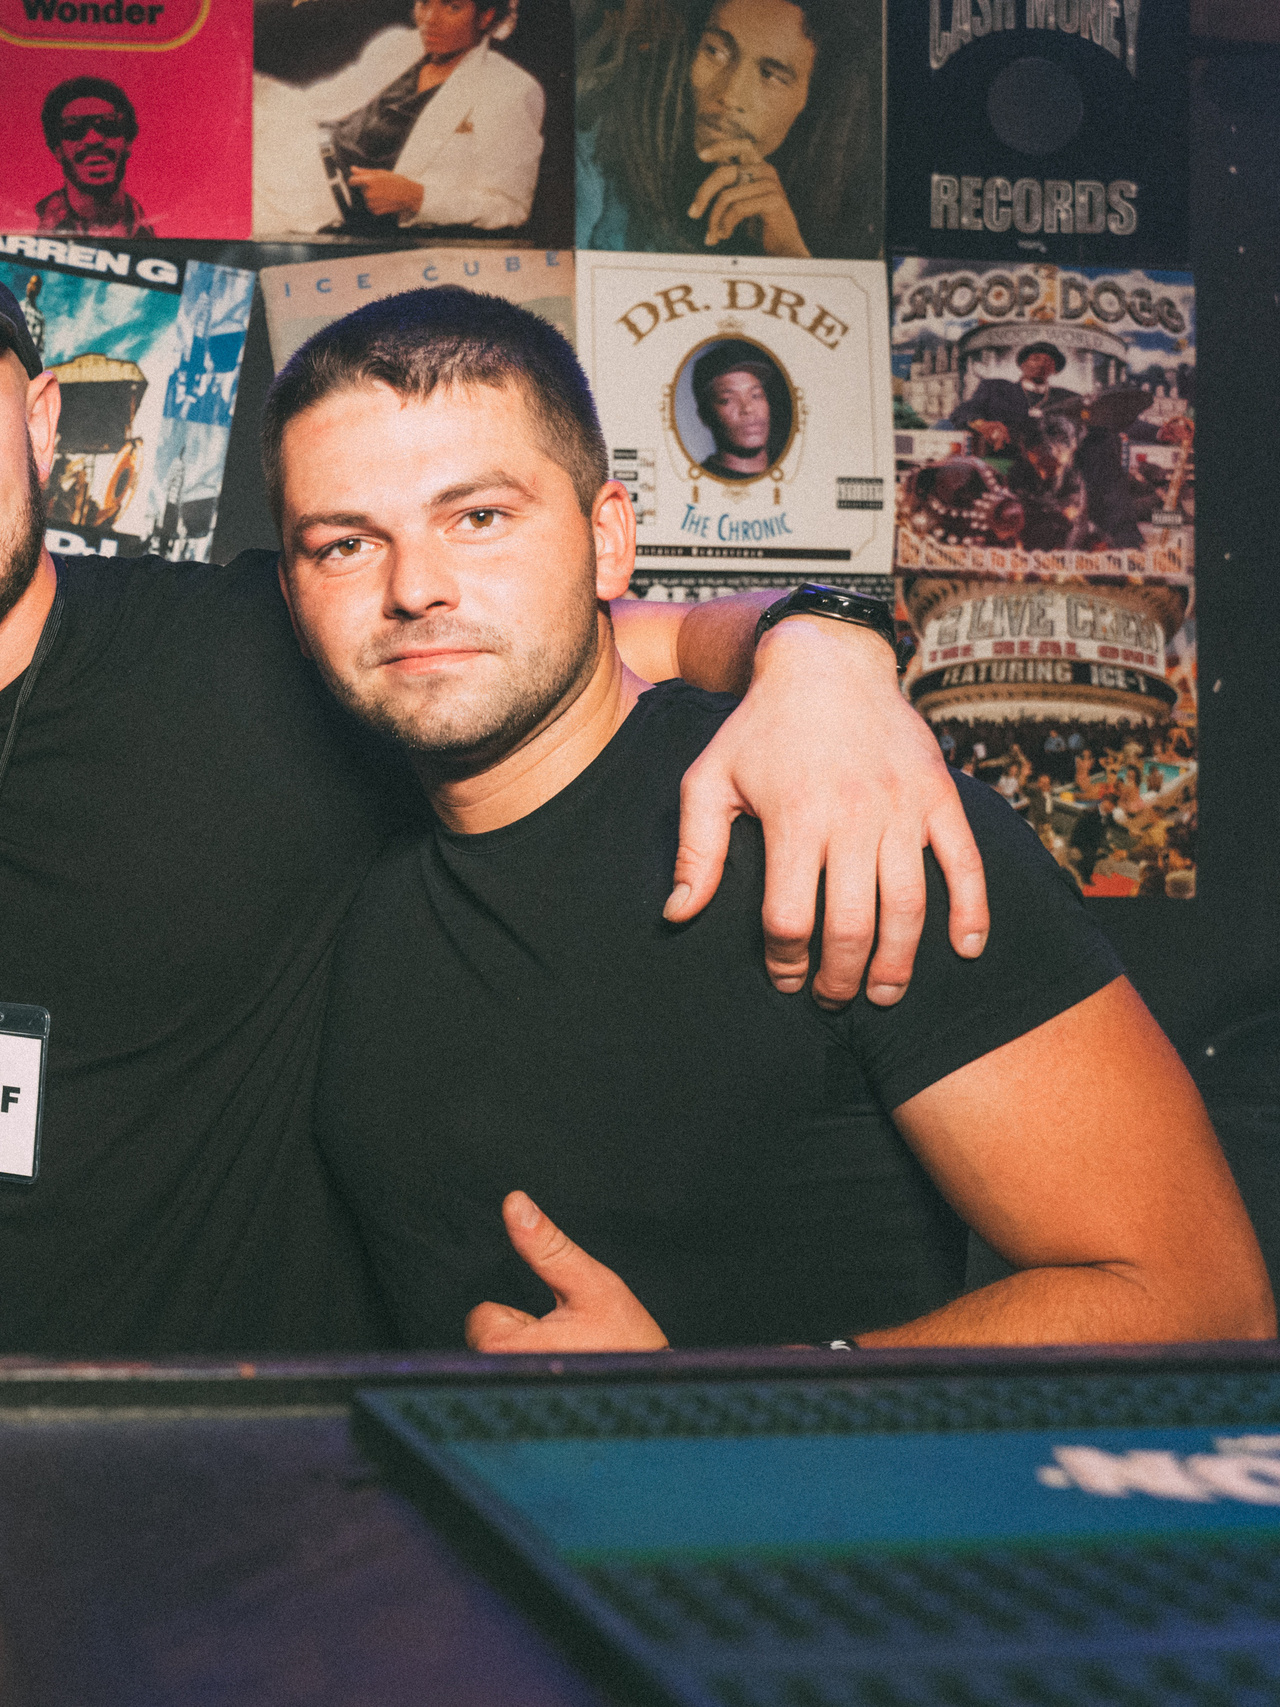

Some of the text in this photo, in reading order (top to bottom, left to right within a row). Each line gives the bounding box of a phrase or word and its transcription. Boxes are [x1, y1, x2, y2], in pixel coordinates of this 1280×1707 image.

[23, 0, 164, 25] Wonder
[930, 173, 1138, 236] RECORDS
[135, 258, 179, 285] G
[284, 251, 560, 298] ICE CUBE
[616, 279, 849, 350] DR. DRE
[901, 275, 1041, 323] SNOOP
[967, 592, 1055, 640] LIVE
[1066, 592, 1161, 653] CREW
